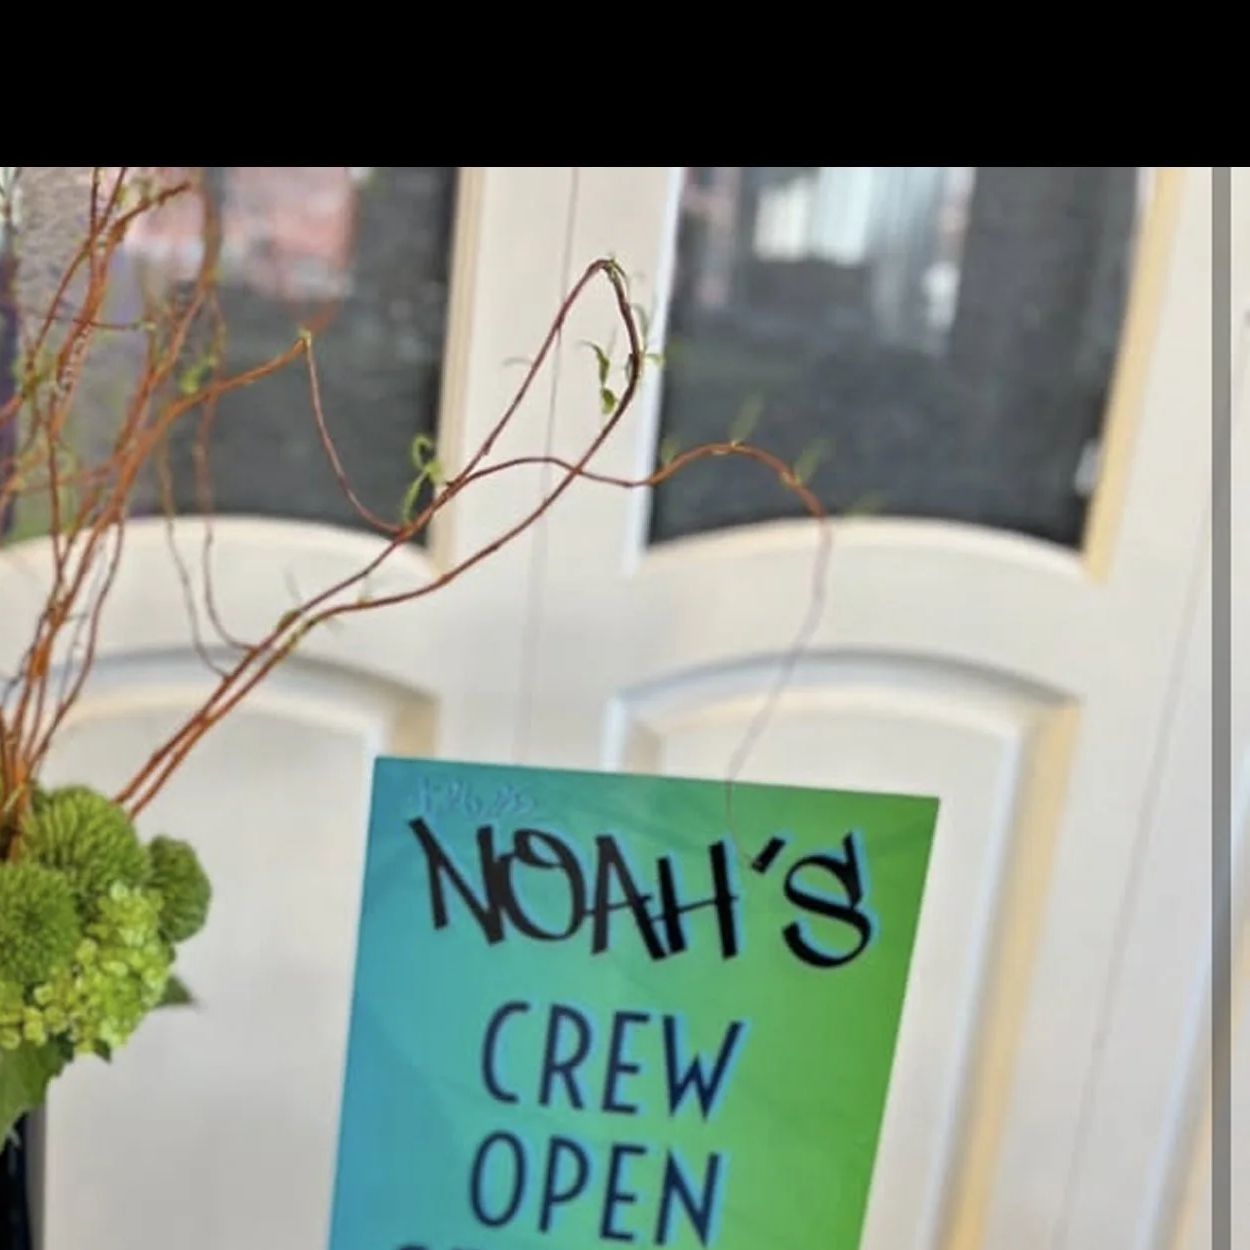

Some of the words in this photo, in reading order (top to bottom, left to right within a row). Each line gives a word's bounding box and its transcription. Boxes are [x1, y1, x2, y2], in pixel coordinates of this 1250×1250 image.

[407, 817, 873, 968] NOAH'S
[481, 1000, 746, 1120] CREW
[469, 1131, 722, 1249] OPEN
